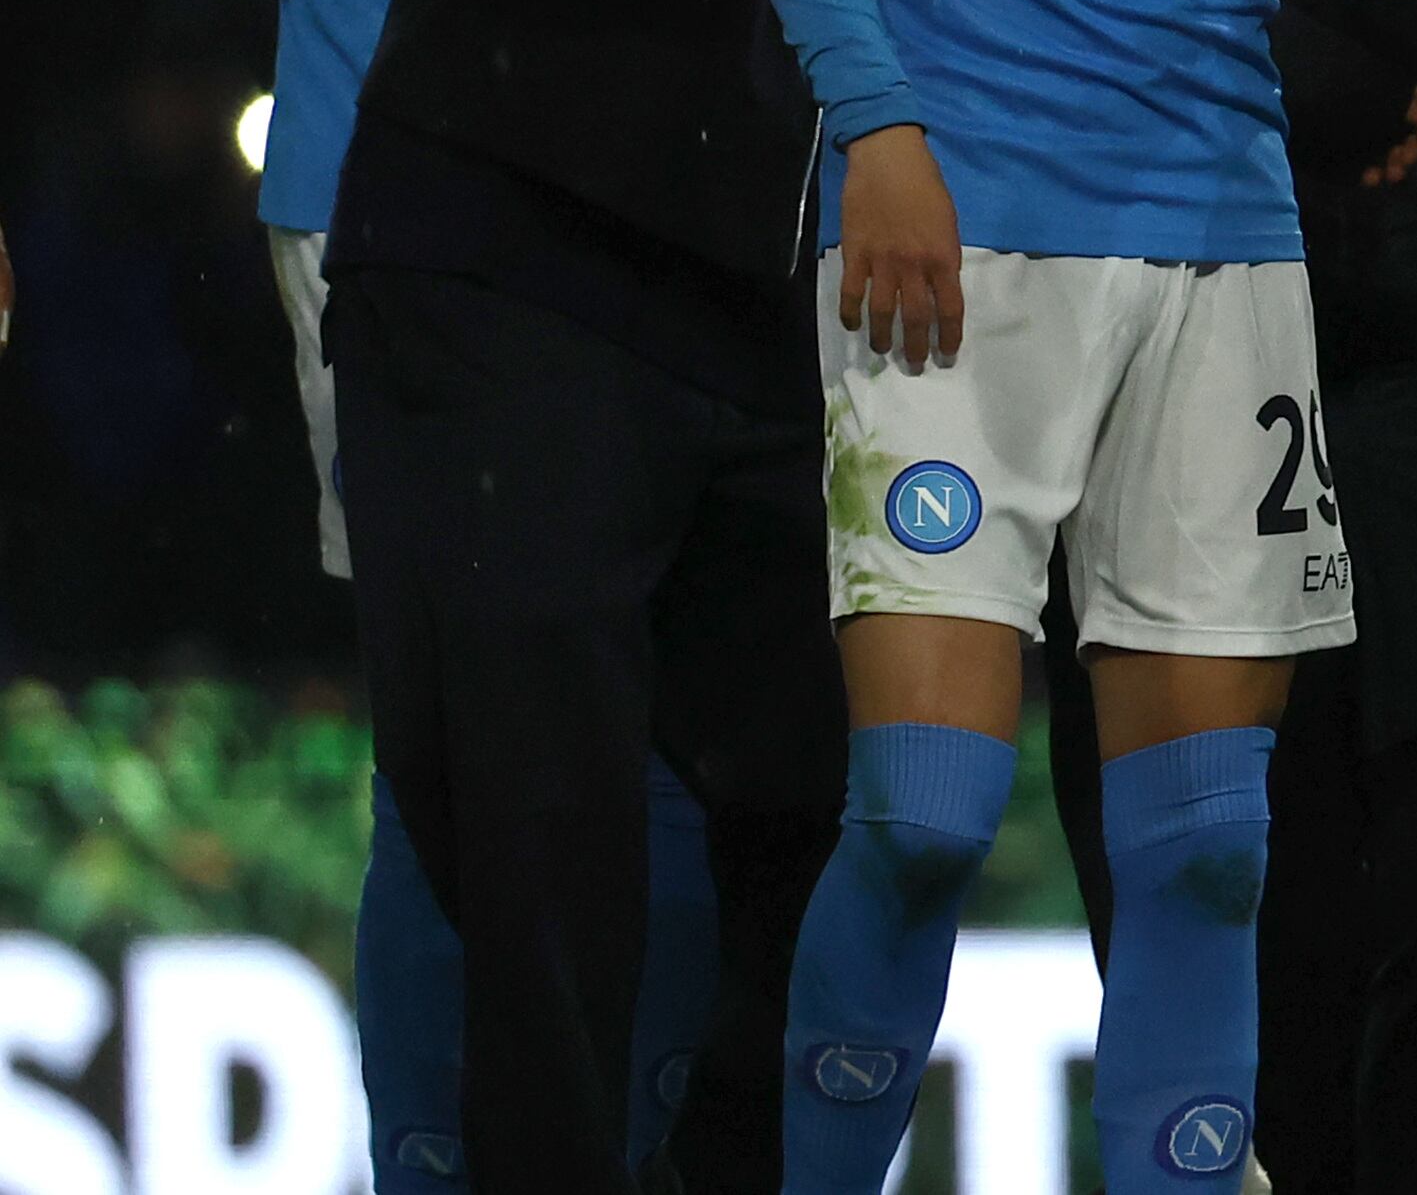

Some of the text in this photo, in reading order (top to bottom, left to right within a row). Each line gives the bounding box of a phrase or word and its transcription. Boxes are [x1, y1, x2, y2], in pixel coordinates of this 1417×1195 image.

[1256, 389, 1338, 536] 29
[912, 486, 954, 528] N
[1184, 1118, 1232, 1157] N
